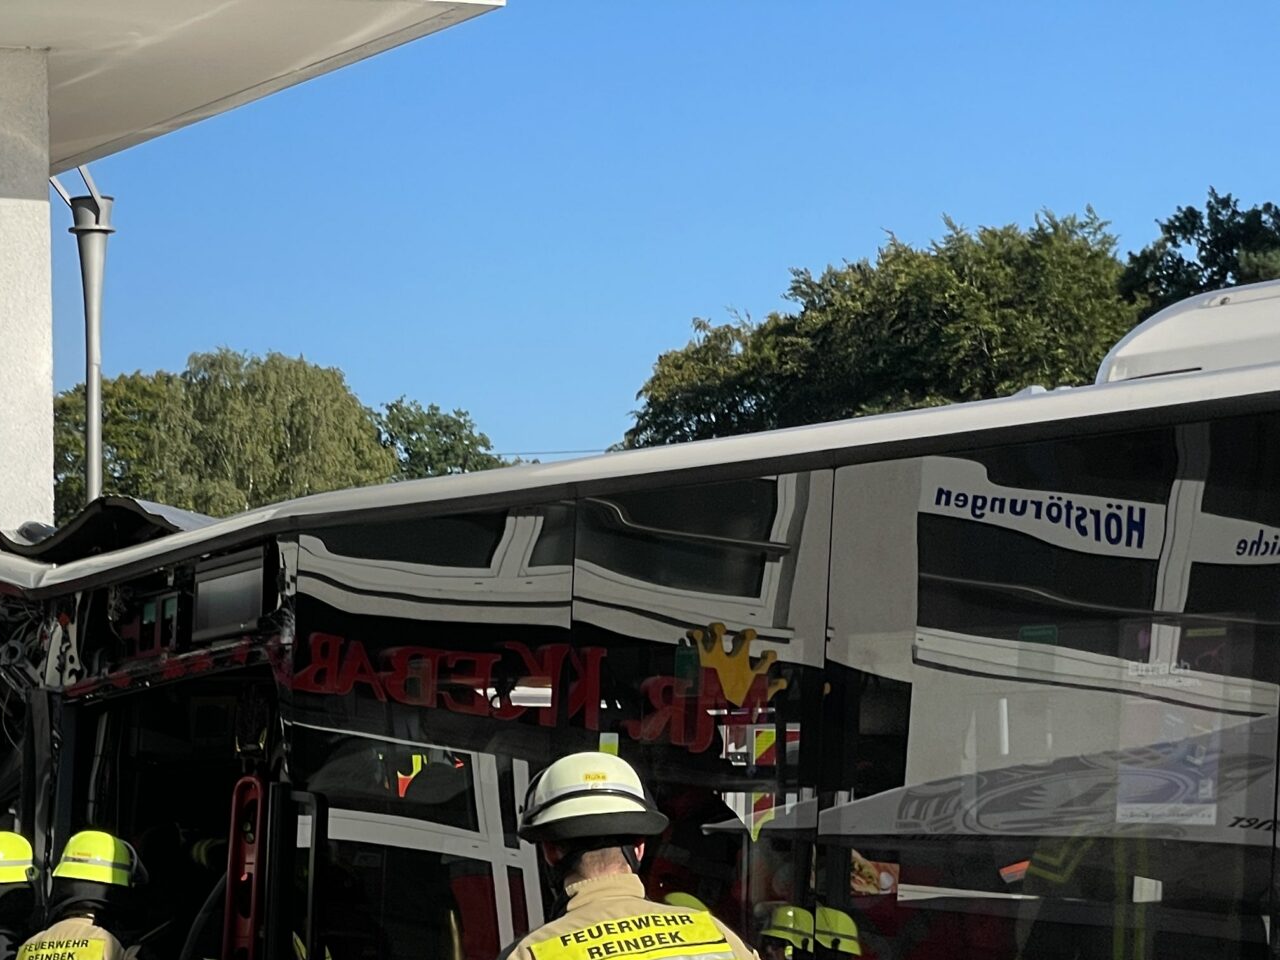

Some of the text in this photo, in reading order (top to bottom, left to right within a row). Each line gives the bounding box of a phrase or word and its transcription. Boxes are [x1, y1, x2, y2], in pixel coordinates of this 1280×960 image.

[559, 914, 694, 947] FEUERWEHR
[24, 939, 89, 952] FEUERWEHR
[587, 931, 686, 960] REINBEK
